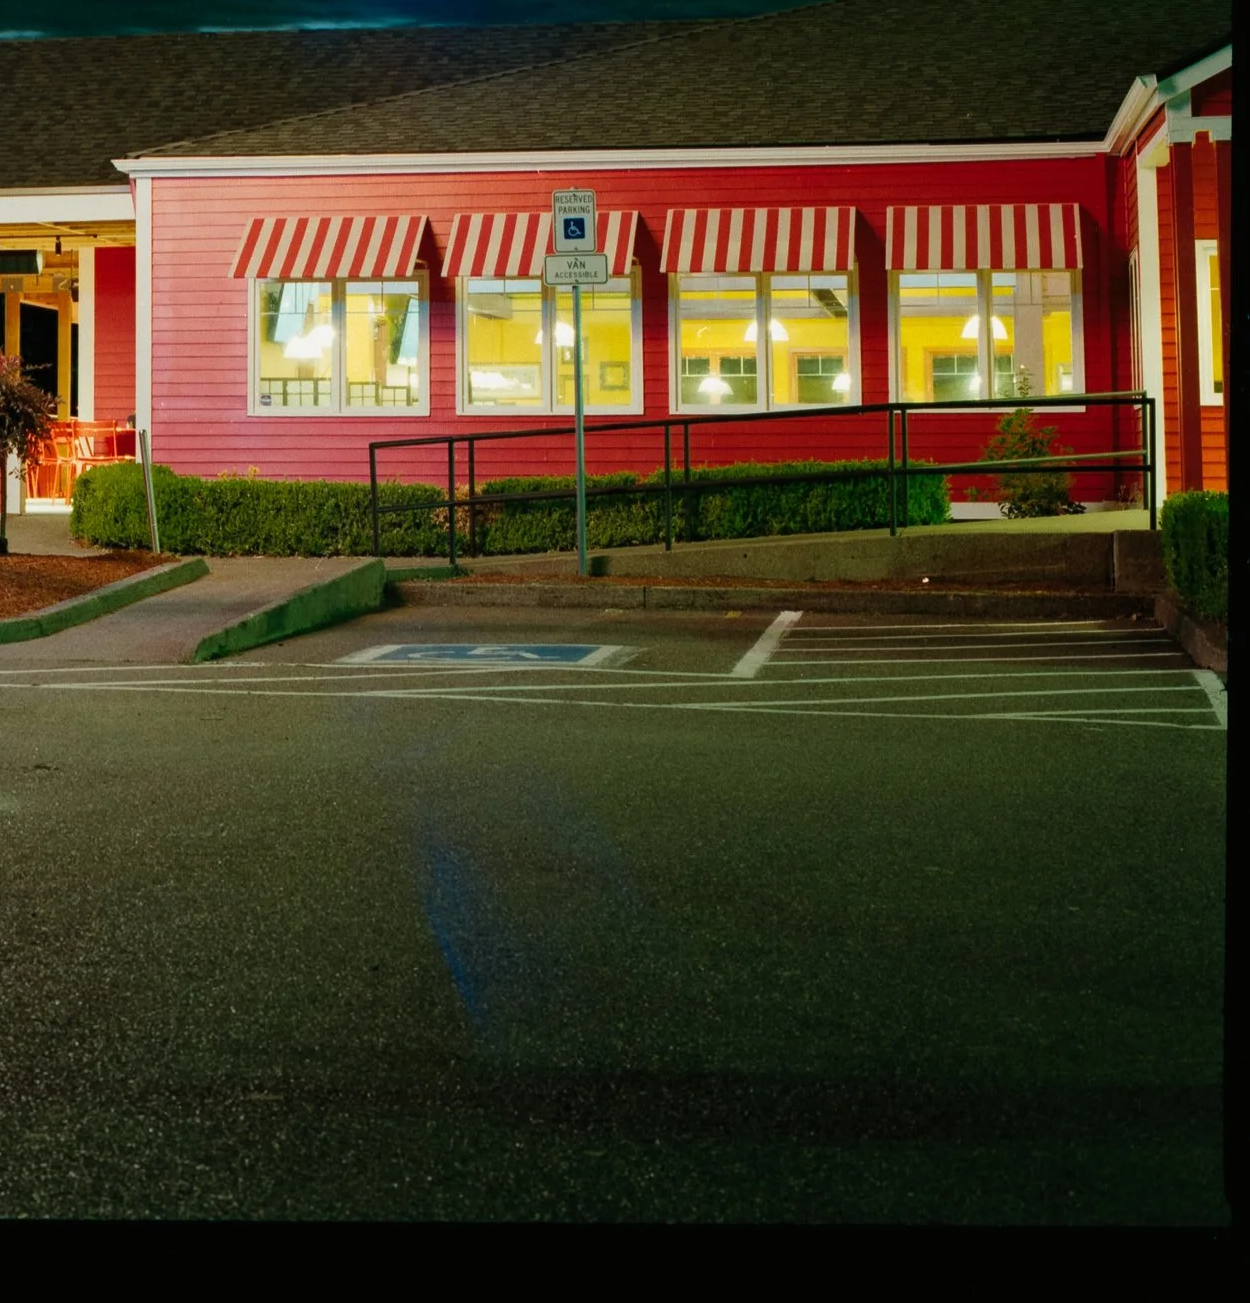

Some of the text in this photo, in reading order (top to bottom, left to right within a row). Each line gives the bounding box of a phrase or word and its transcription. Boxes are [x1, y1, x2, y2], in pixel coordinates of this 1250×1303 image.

[555, 195, 593, 204] RESERVED
[558, 206, 590, 214] PARKING
[567, 260, 586, 269] VAN
[555, 271, 598, 279] ACCESSIBLE
